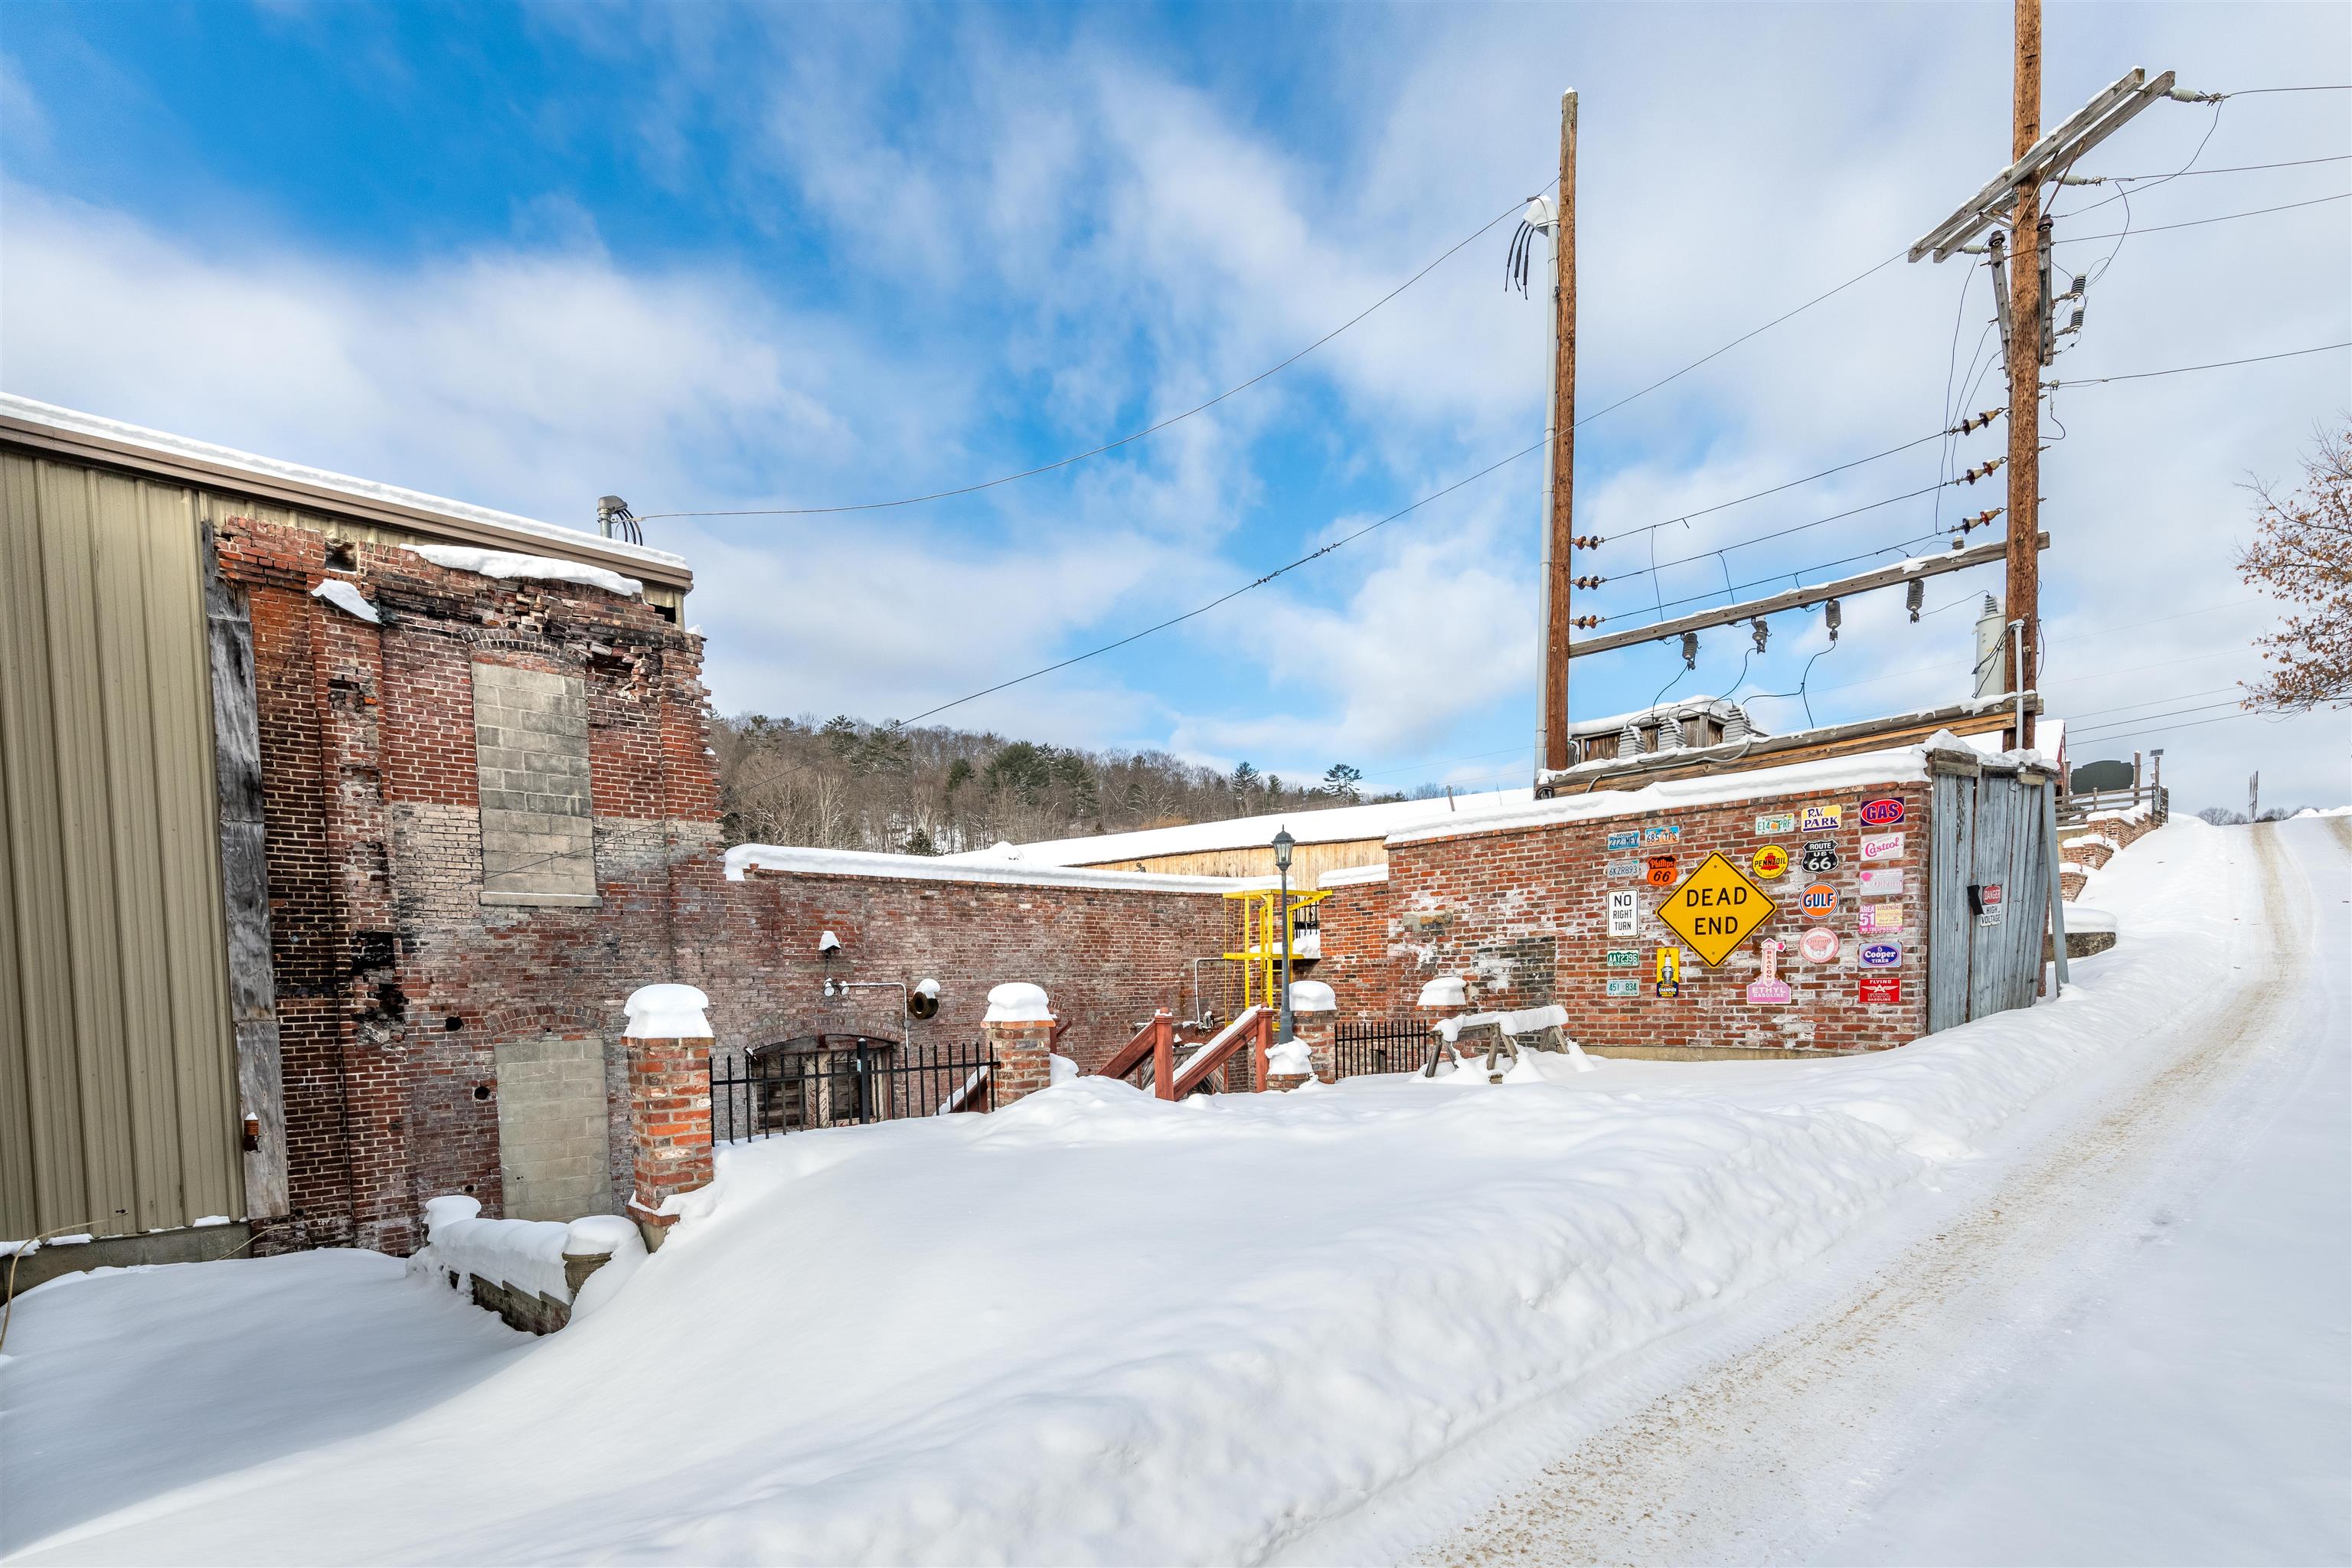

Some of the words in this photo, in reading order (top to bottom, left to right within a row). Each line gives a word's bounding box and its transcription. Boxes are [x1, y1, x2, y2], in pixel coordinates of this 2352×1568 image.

[1808, 808, 1824, 818] R.V.
[1866, 803, 1899, 820] GAS
[1758, 822, 1769, 831] E14
[1805, 816, 1838, 828] PARK
[1647, 833, 1660, 843] 685
[1865, 837, 1900, 858] Castrol
[1650, 859, 1674, 869] Phillips
[1754, 858, 1787, 867] PENNZOIL
[1808, 858, 1831, 871] 66
[1609, 866, 1638, 876] 6KZR893
[1654, 871, 1671, 882] 66
[1614, 894, 1632, 906] NO
[1687, 887, 1747, 907] DEAD
[1984, 890, 2001, 900] DANGER
[1804, 893, 1835, 908] GULF
[1613, 910, 1632, 919] RIGHT
[1986, 906, 1998, 914] HIGH
[1860, 913, 1875, 926] 51
[1981, 913, 2001, 924] VOLTAGE
[1615, 921, 1632, 931] TURN
[1694, 916, 1738, 936] END
[1609, 954, 1638, 962] AAY2396
[1609, 983, 1619, 991] 451
